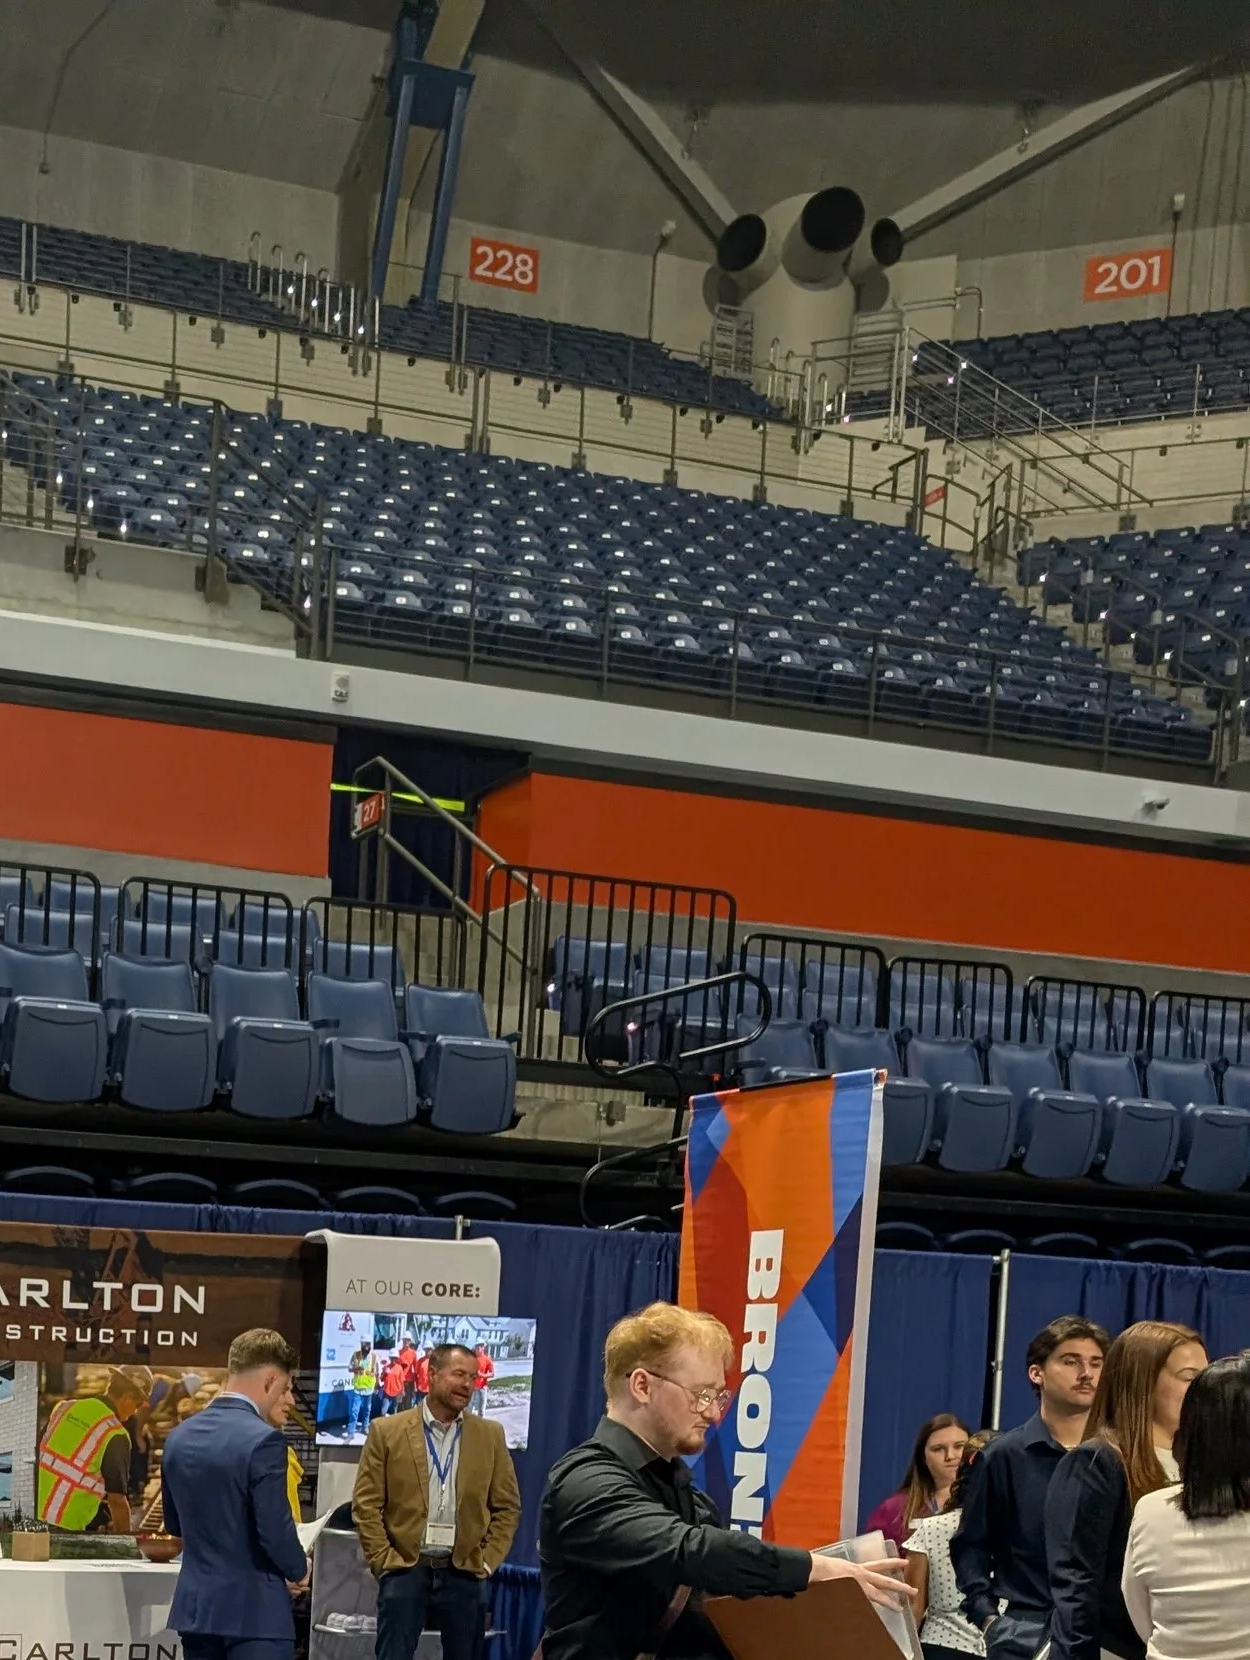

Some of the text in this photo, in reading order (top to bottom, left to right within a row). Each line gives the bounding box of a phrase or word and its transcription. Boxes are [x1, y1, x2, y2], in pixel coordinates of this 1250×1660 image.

[474, 245, 534, 285] 228
[1094, 255, 1161, 294] 201
[363, 801, 376, 822] 27
[346, 1279, 480, 1298] AT OUR CORE:
[730, 1229, 784, 1539] BRON
